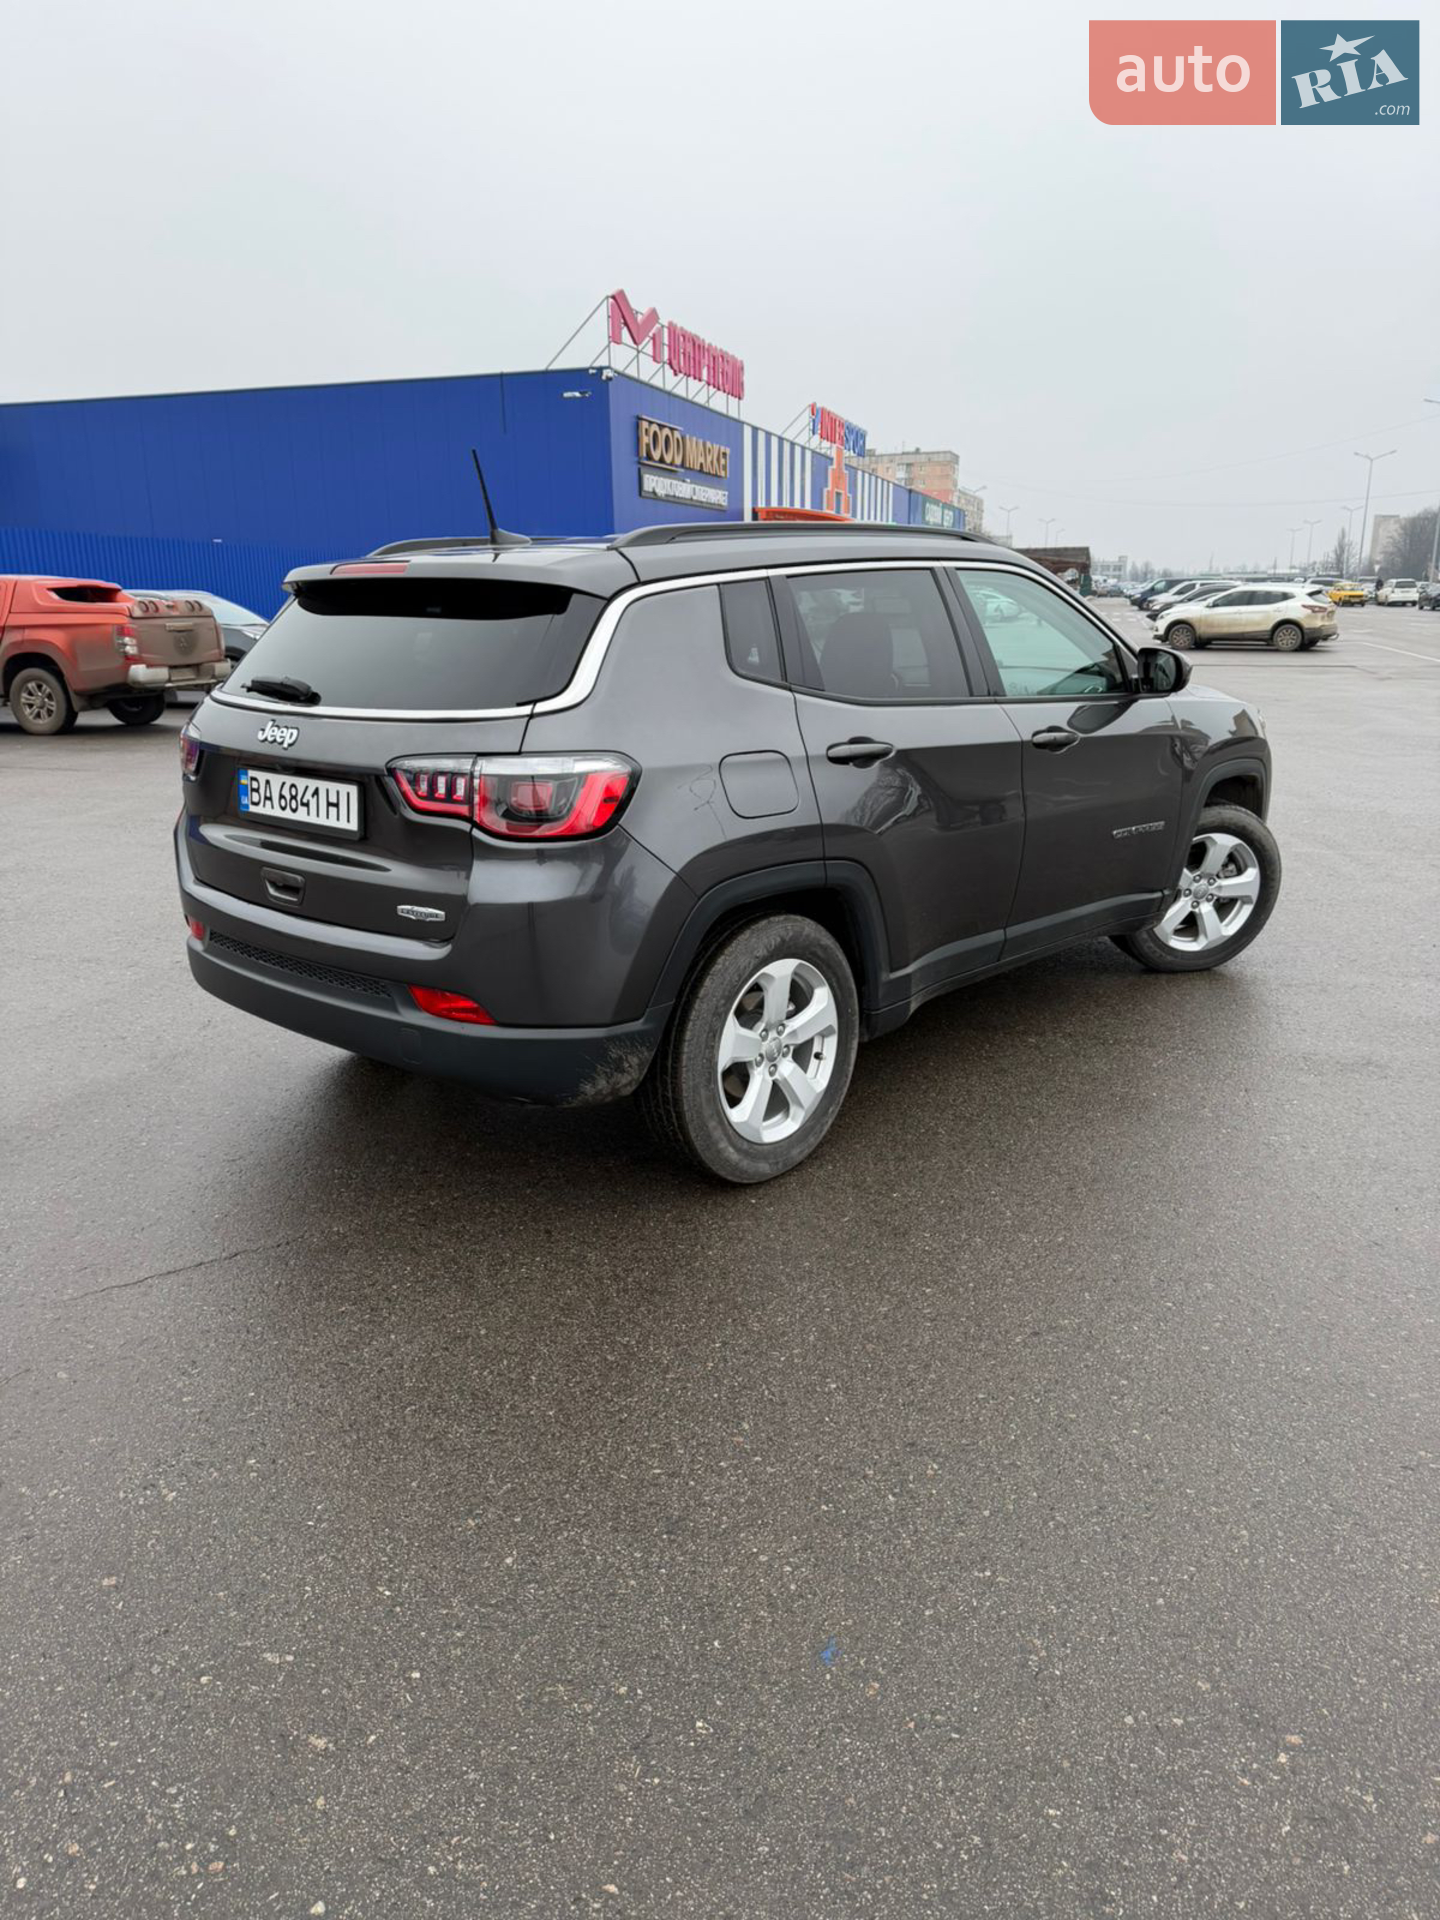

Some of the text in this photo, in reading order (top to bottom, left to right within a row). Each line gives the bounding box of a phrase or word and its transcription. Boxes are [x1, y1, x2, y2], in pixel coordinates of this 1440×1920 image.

[638, 419, 731, 480] FOOD MARKET
[257, 719, 300, 749] Jeep
[278, 781, 320, 818] 6841
